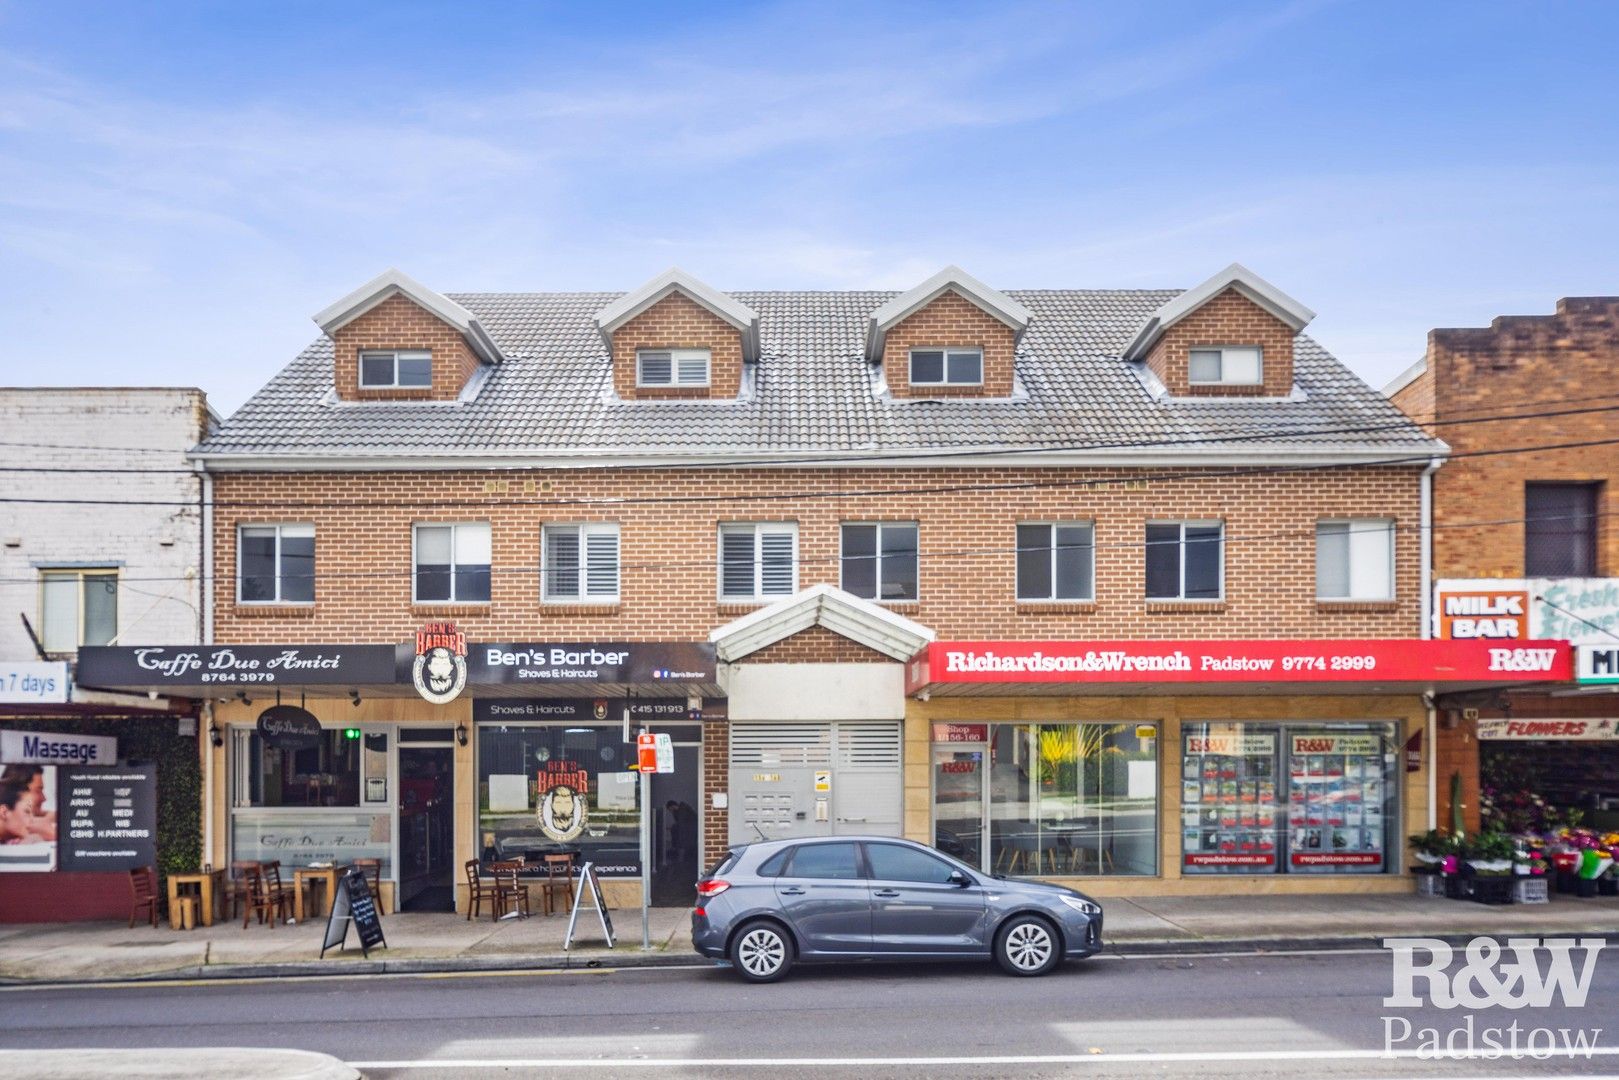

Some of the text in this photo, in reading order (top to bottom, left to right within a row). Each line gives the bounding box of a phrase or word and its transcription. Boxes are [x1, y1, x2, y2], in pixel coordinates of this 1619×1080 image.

[1445, 595, 1524, 616] MILK
[425, 623, 456, 634] BEN'S
[1451, 619, 1520, 638] BAR
[416, 631, 468, 656] BARBER
[208, 649, 260, 670] Due
[266, 649, 341, 670] Amici
[487, 649, 629, 666] Ben's Barber
[946, 651, 1376, 672] Richardson&Wrench Padstow 9774 2999
[1488, 648, 1557, 671] R&W
[201, 672, 275, 682] 8764 3979
[518, 668, 599, 678] Shaves & Haircuts
[9, 674, 17, 691] 7
[21, 674, 56, 696] days
[490, 705, 576, 714] Shaves & Haircuts
[948, 725, 970, 734] Shop
[1506, 721, 1588, 736] FLOWERS
[23, 735, 98, 765] Massage
[1295, 738, 1335, 752] R&W
[537, 768, 588, 795] BARBER
[594, 865, 638, 874] experience
